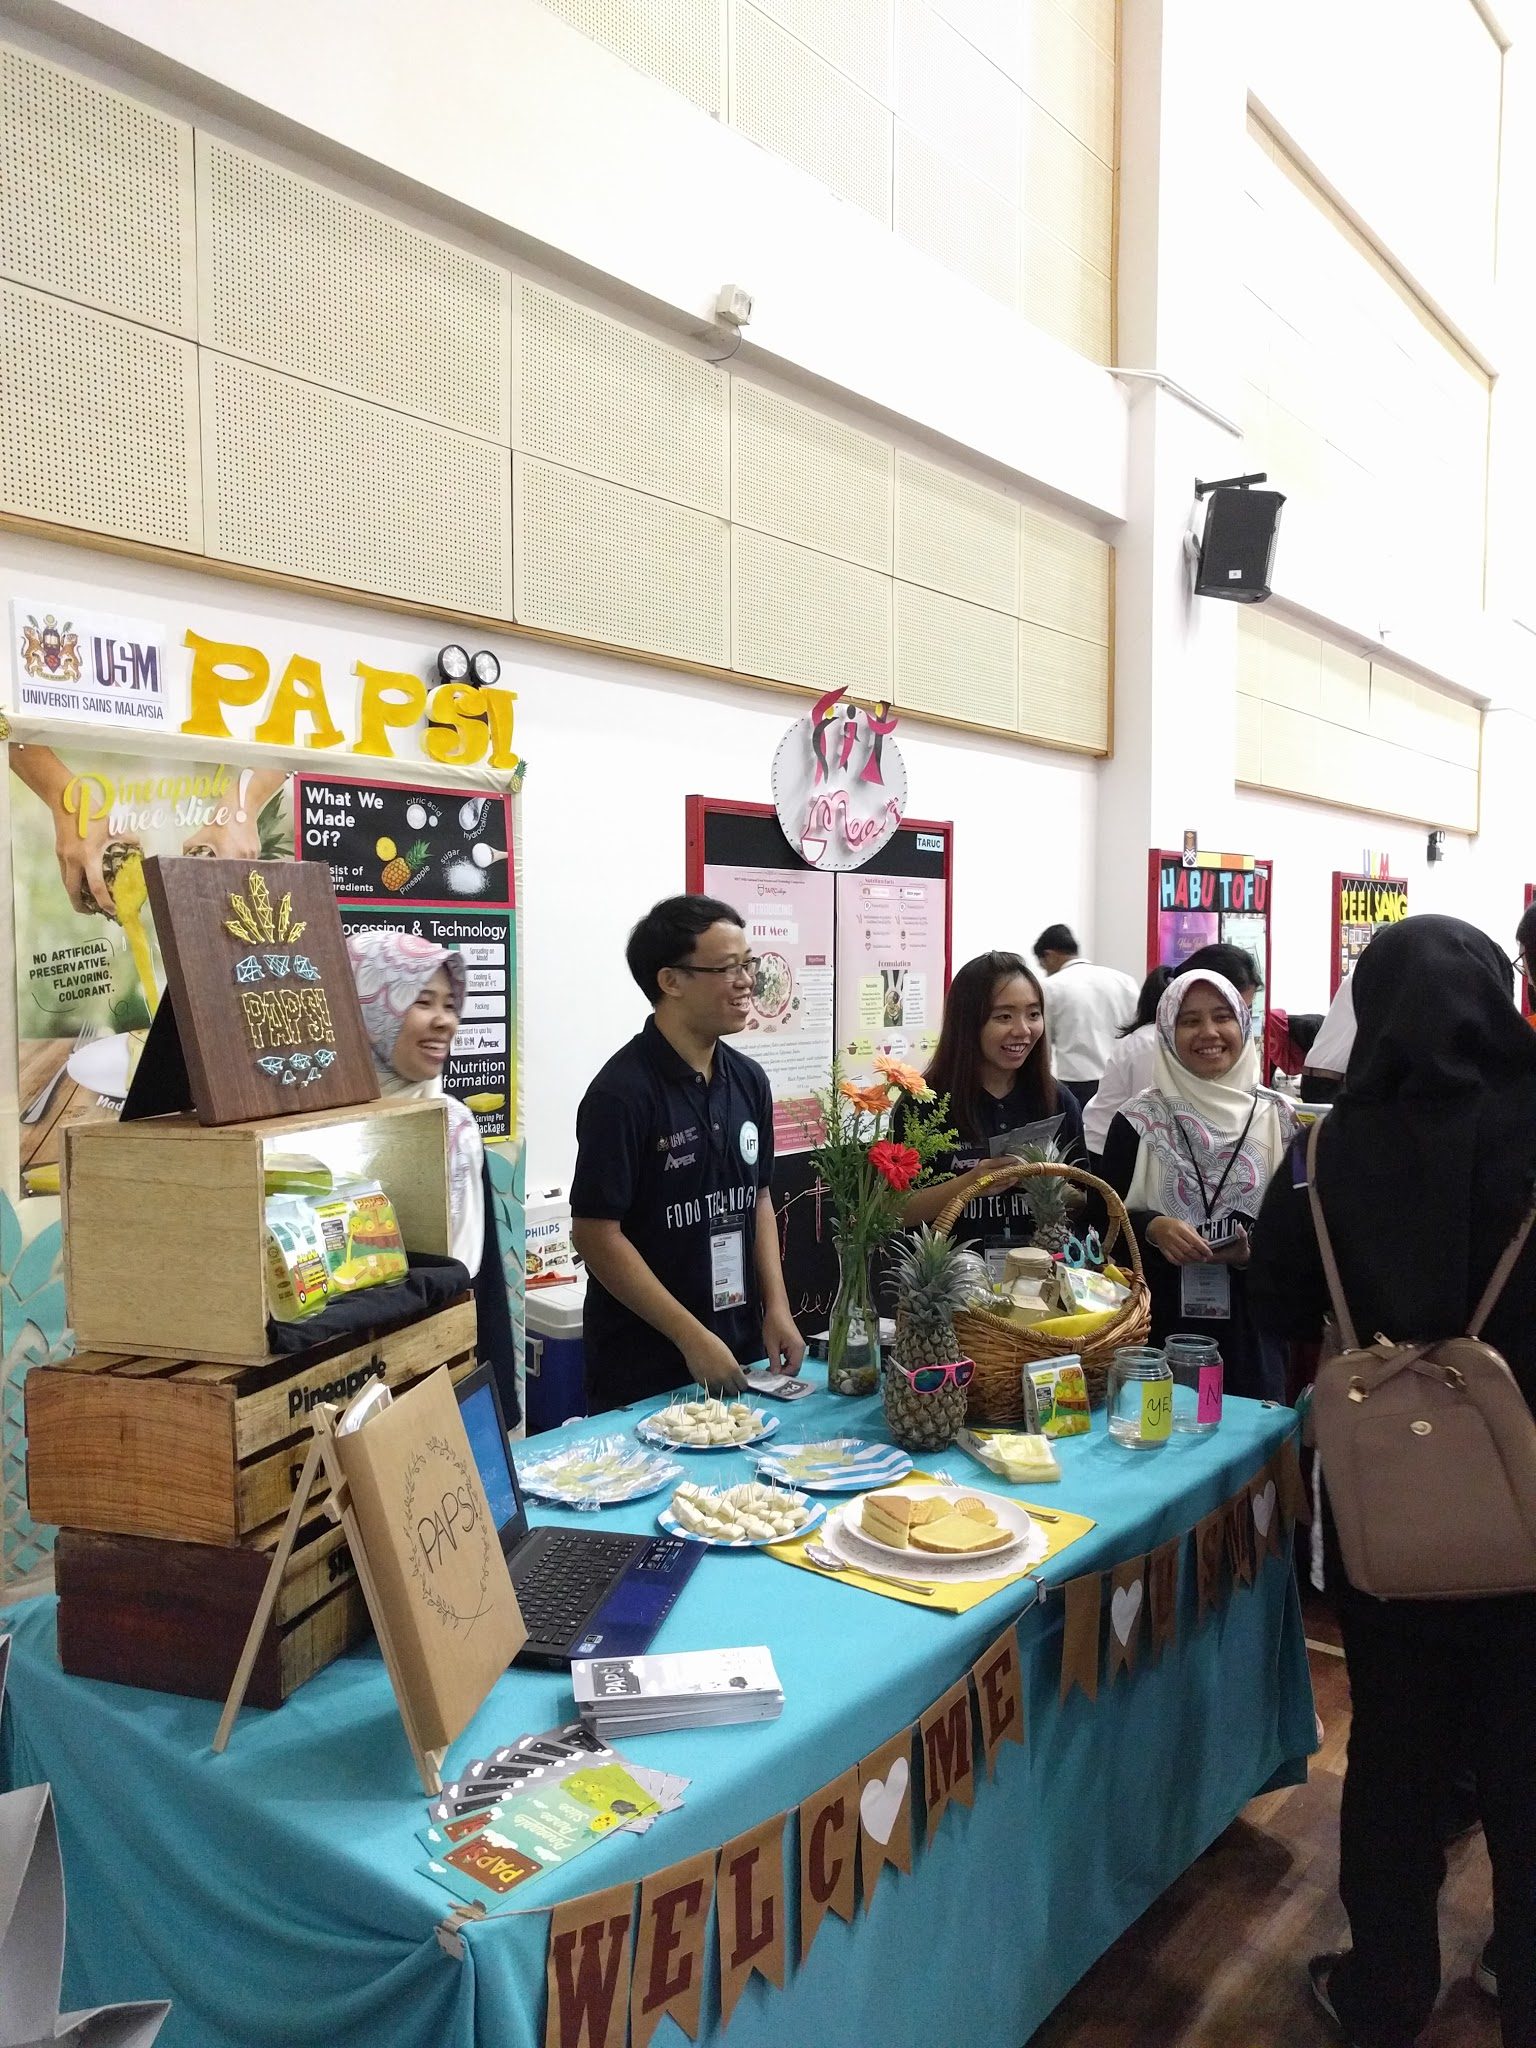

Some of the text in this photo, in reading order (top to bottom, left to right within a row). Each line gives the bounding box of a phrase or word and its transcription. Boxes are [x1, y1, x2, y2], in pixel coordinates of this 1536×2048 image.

[94, 637, 159, 693] USM
[22, 688, 164, 720] UNIVERSITI SAINS MALAYSIA
[305, 786, 384, 810] What We
[406, 797, 443, 817] citric acid
[305, 808, 356, 828] Made
[463, 800, 492, 841] hydrocolloids
[305, 830, 341, 848] Of?
[917, 837, 941, 849] TARUC
[440, 848, 461, 865] sugar
[351, 866, 364, 876] of
[400, 864, 431, 896] Pineapple
[1161, 867, 1267, 911] HABU TOFU
[1341, 890, 1374, 925] PEEL
[411, 920, 424, 937] &
[430, 920, 508, 941] Technology
[32, 953, 47, 965] NO
[51, 943, 107, 962] ARTIFICIAL
[58, 983, 115, 1003] COLORANT.
[449, 1059, 506, 1075] Nutrition
[475, 1113, 505, 1124] Serving Per
[666, 1198, 701, 1229] FOOD
[525, 1222, 560, 1240] PHILIPS
